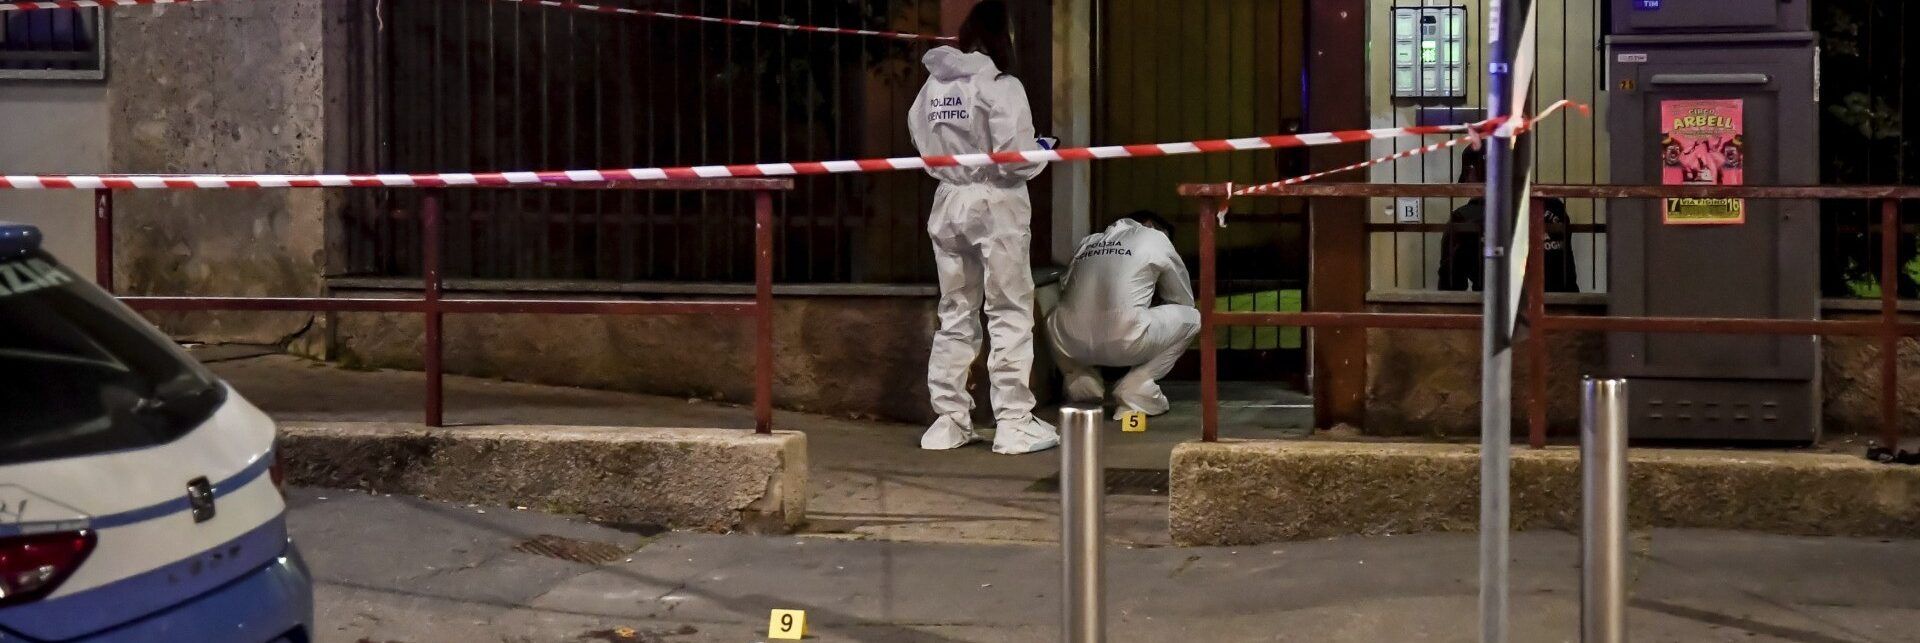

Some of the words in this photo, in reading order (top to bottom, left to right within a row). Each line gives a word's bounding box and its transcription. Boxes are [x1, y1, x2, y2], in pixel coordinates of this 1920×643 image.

[1405, 206, 1414, 217] B
[1130, 415, 1139, 428] 5
[781, 613, 793, 632] 9
